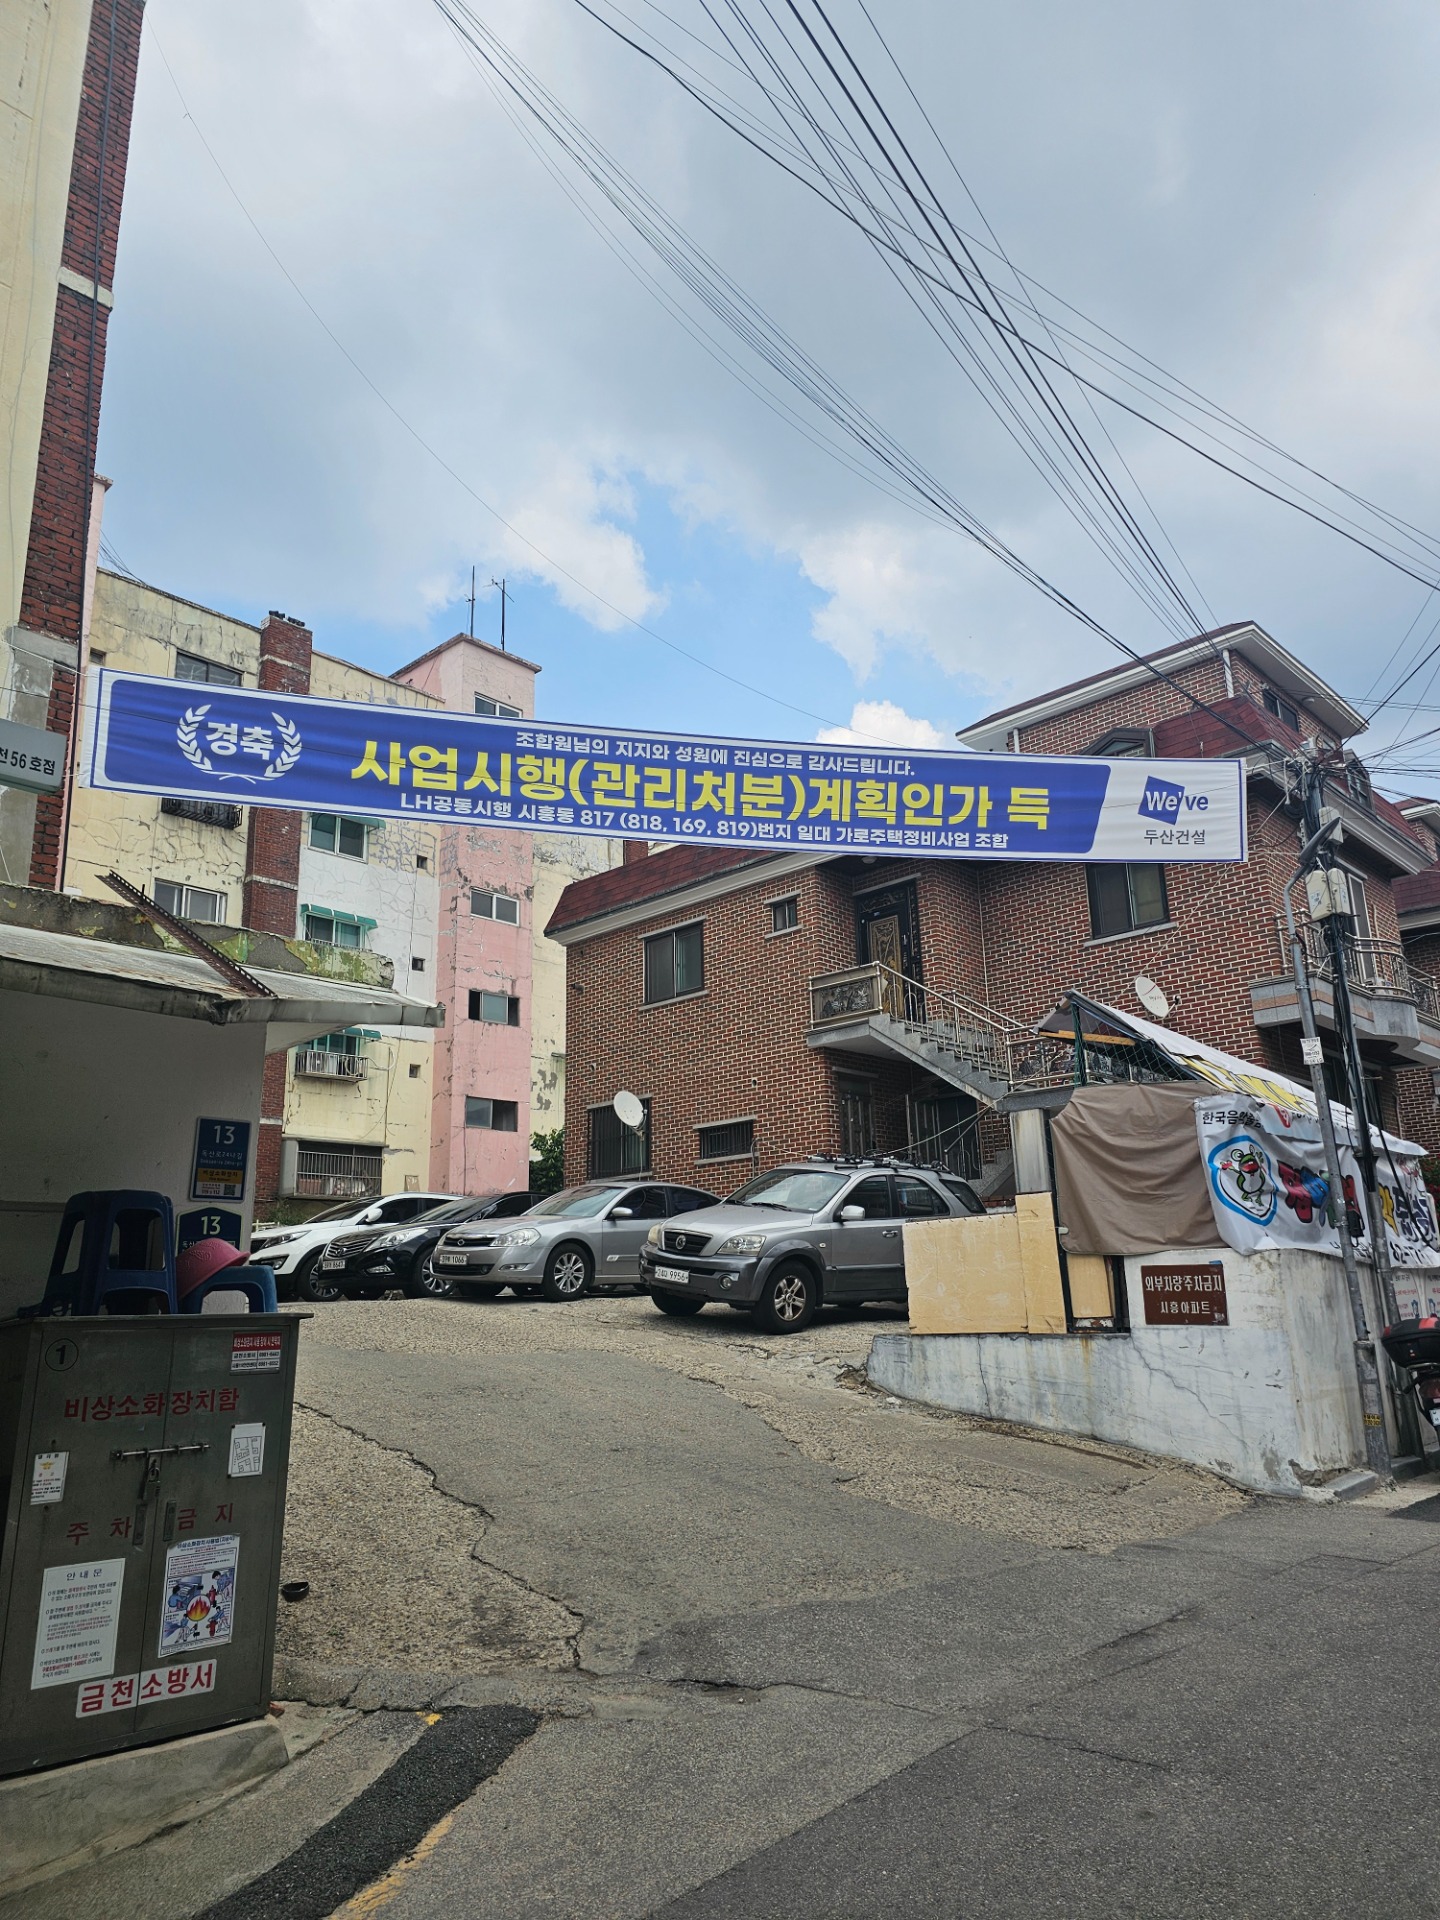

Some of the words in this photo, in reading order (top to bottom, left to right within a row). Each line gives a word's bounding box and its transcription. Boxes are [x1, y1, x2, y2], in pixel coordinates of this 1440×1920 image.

[206, 722, 274, 760] 경축
[516, 731, 608, 755] 조합원님의
[616, 741, 670, 760] 지지와
[675, 746, 728, 765] 성원에
[734, 750, 803, 770] 진심으로
[809, 755, 915, 776] 감사드립니다.
[1008, 787, 1050, 830] 득
[1145, 791, 1209, 811] We've
[401, 792, 512, 818] LH공동시행
[518, 803, 575, 823] 시흥동
[580, 809, 615, 828] 817
[619, 811, 667, 832] (818,
[673, 817, 711, 836] 169,
[716, 820, 791, 840] 819)번지
[797, 825, 831, 842] 일대
[836, 827, 970, 847] 가로주택정비사업
[975, 833, 1009, 849] 조합
[1144, 829, 1205, 845] 두산건설
[213, 1125, 236, 1145] 13
[201, 1215, 221, 1235] 13
[669, 1270, 686, 1282] 9956
[56, 1344, 66, 1365] 1
[64, 1387, 240, 1422] 비상소화장치함
[82, 1663, 213, 1713] 금천소방서
